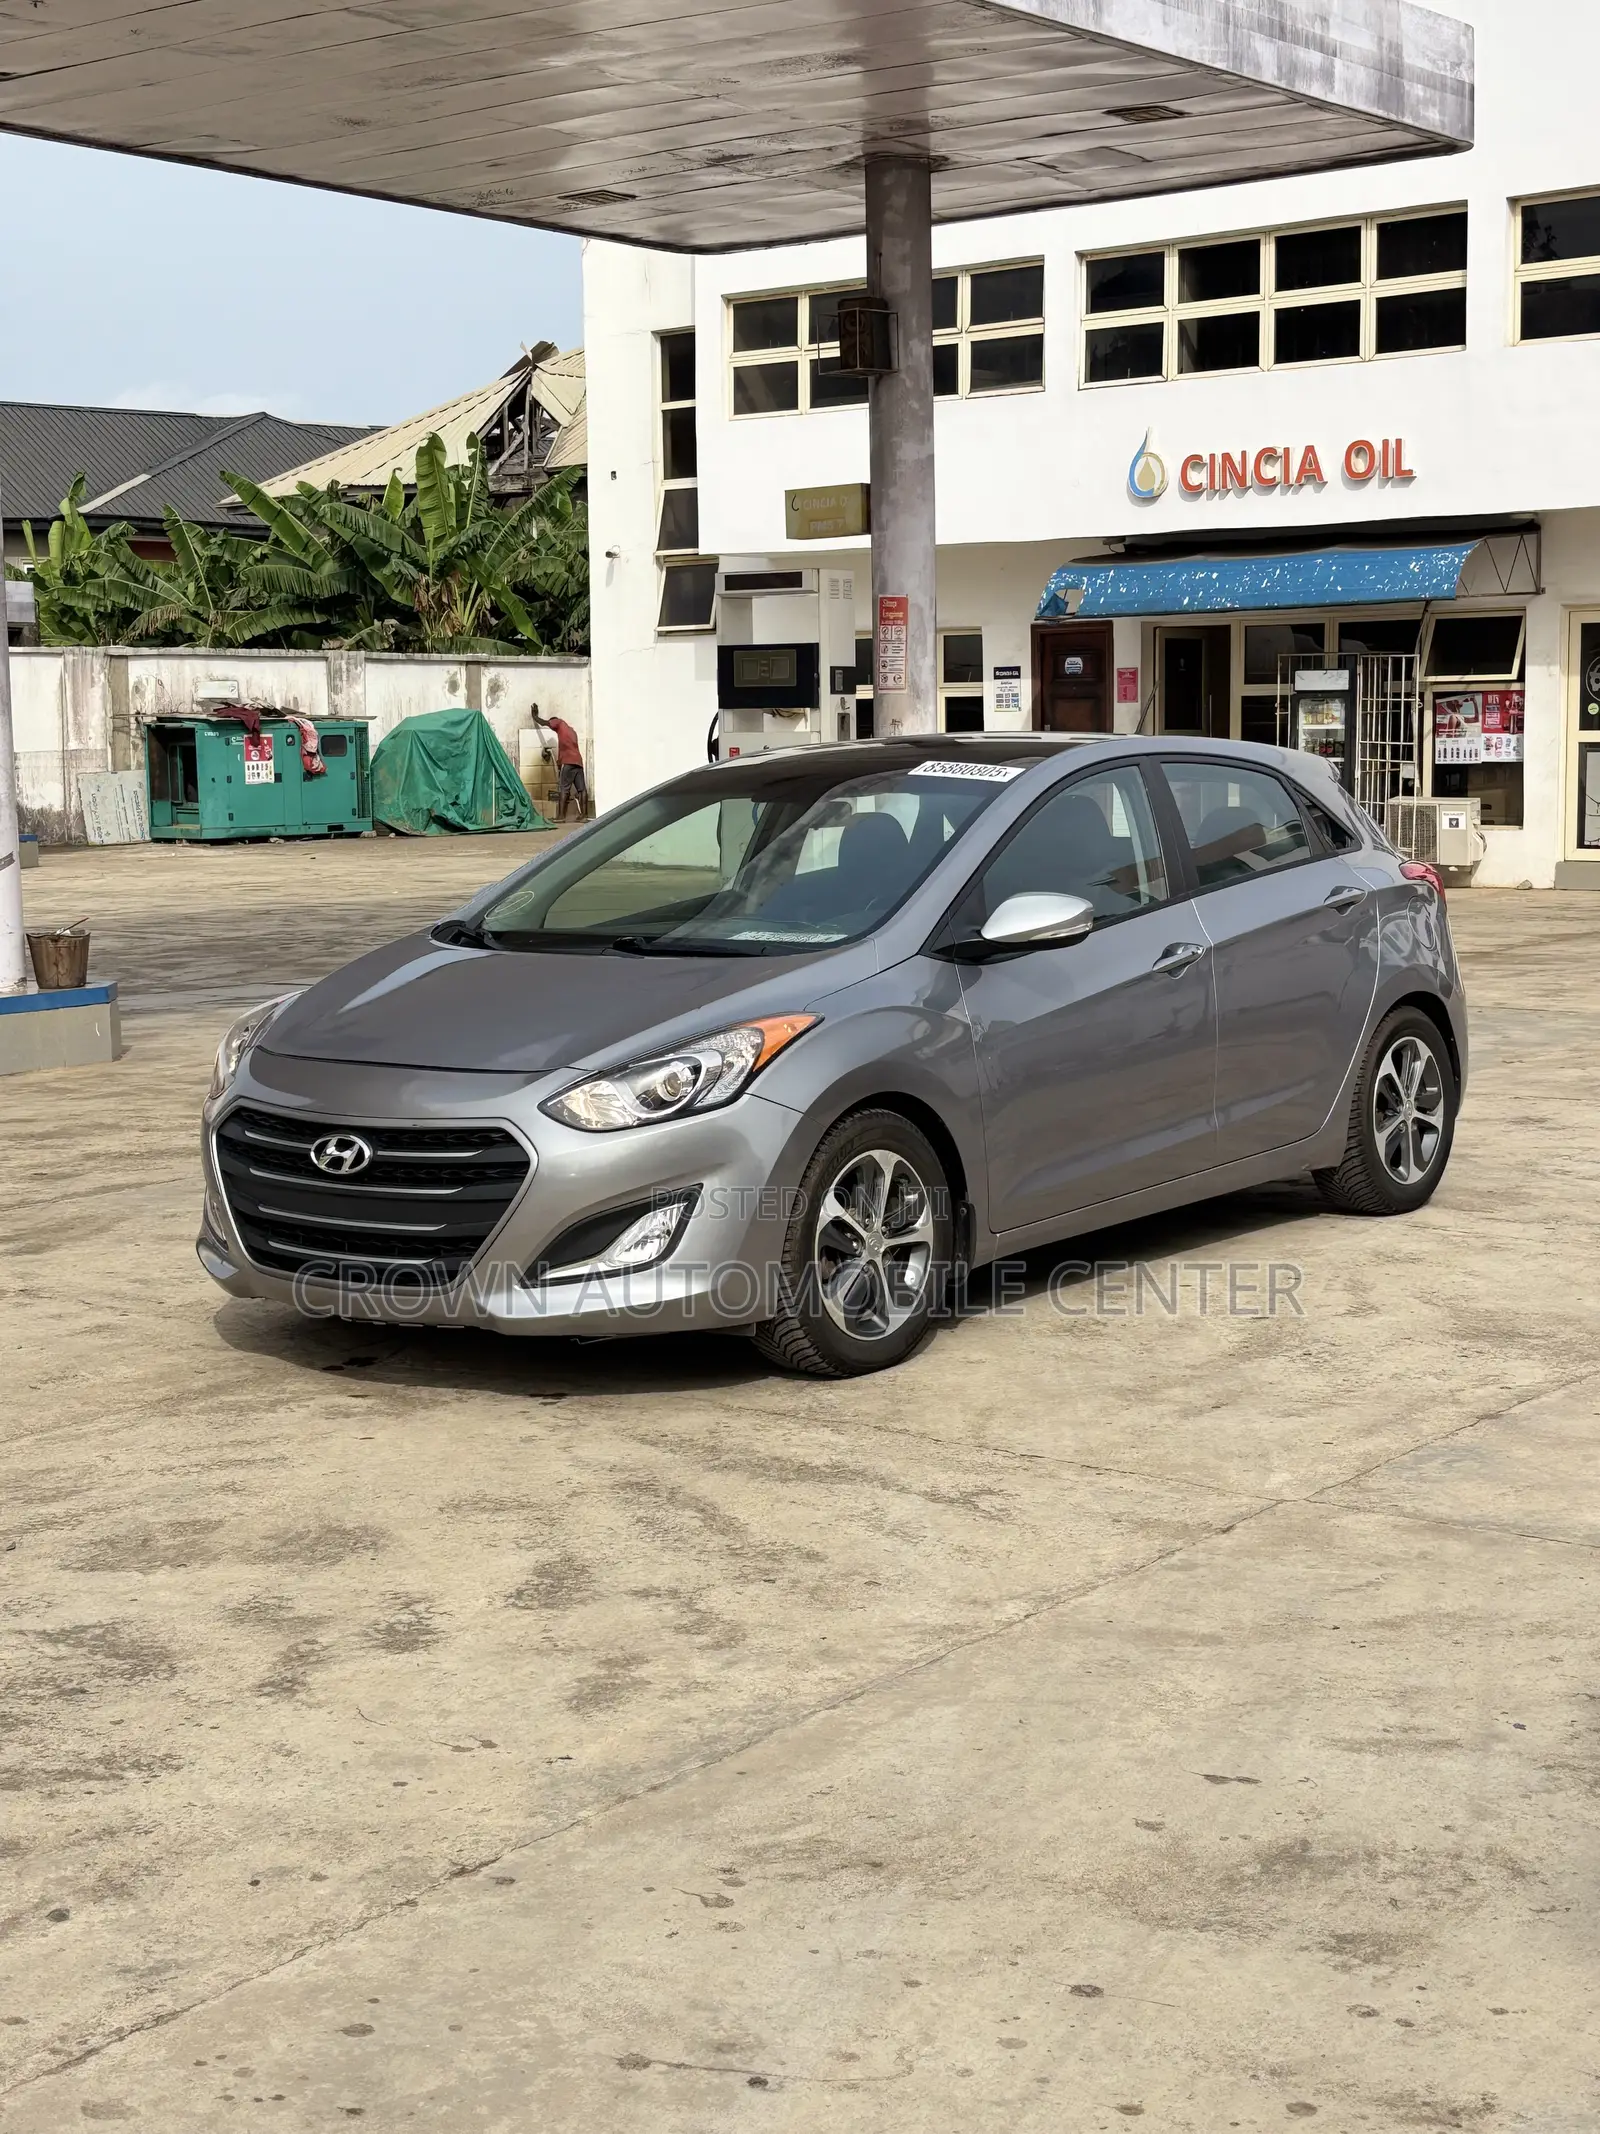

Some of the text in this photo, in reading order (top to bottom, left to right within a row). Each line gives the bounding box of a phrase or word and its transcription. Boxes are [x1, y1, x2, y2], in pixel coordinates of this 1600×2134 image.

[1180, 438, 1414, 493] CINCIA OIL
[803, 496, 837, 511] CINCIA
